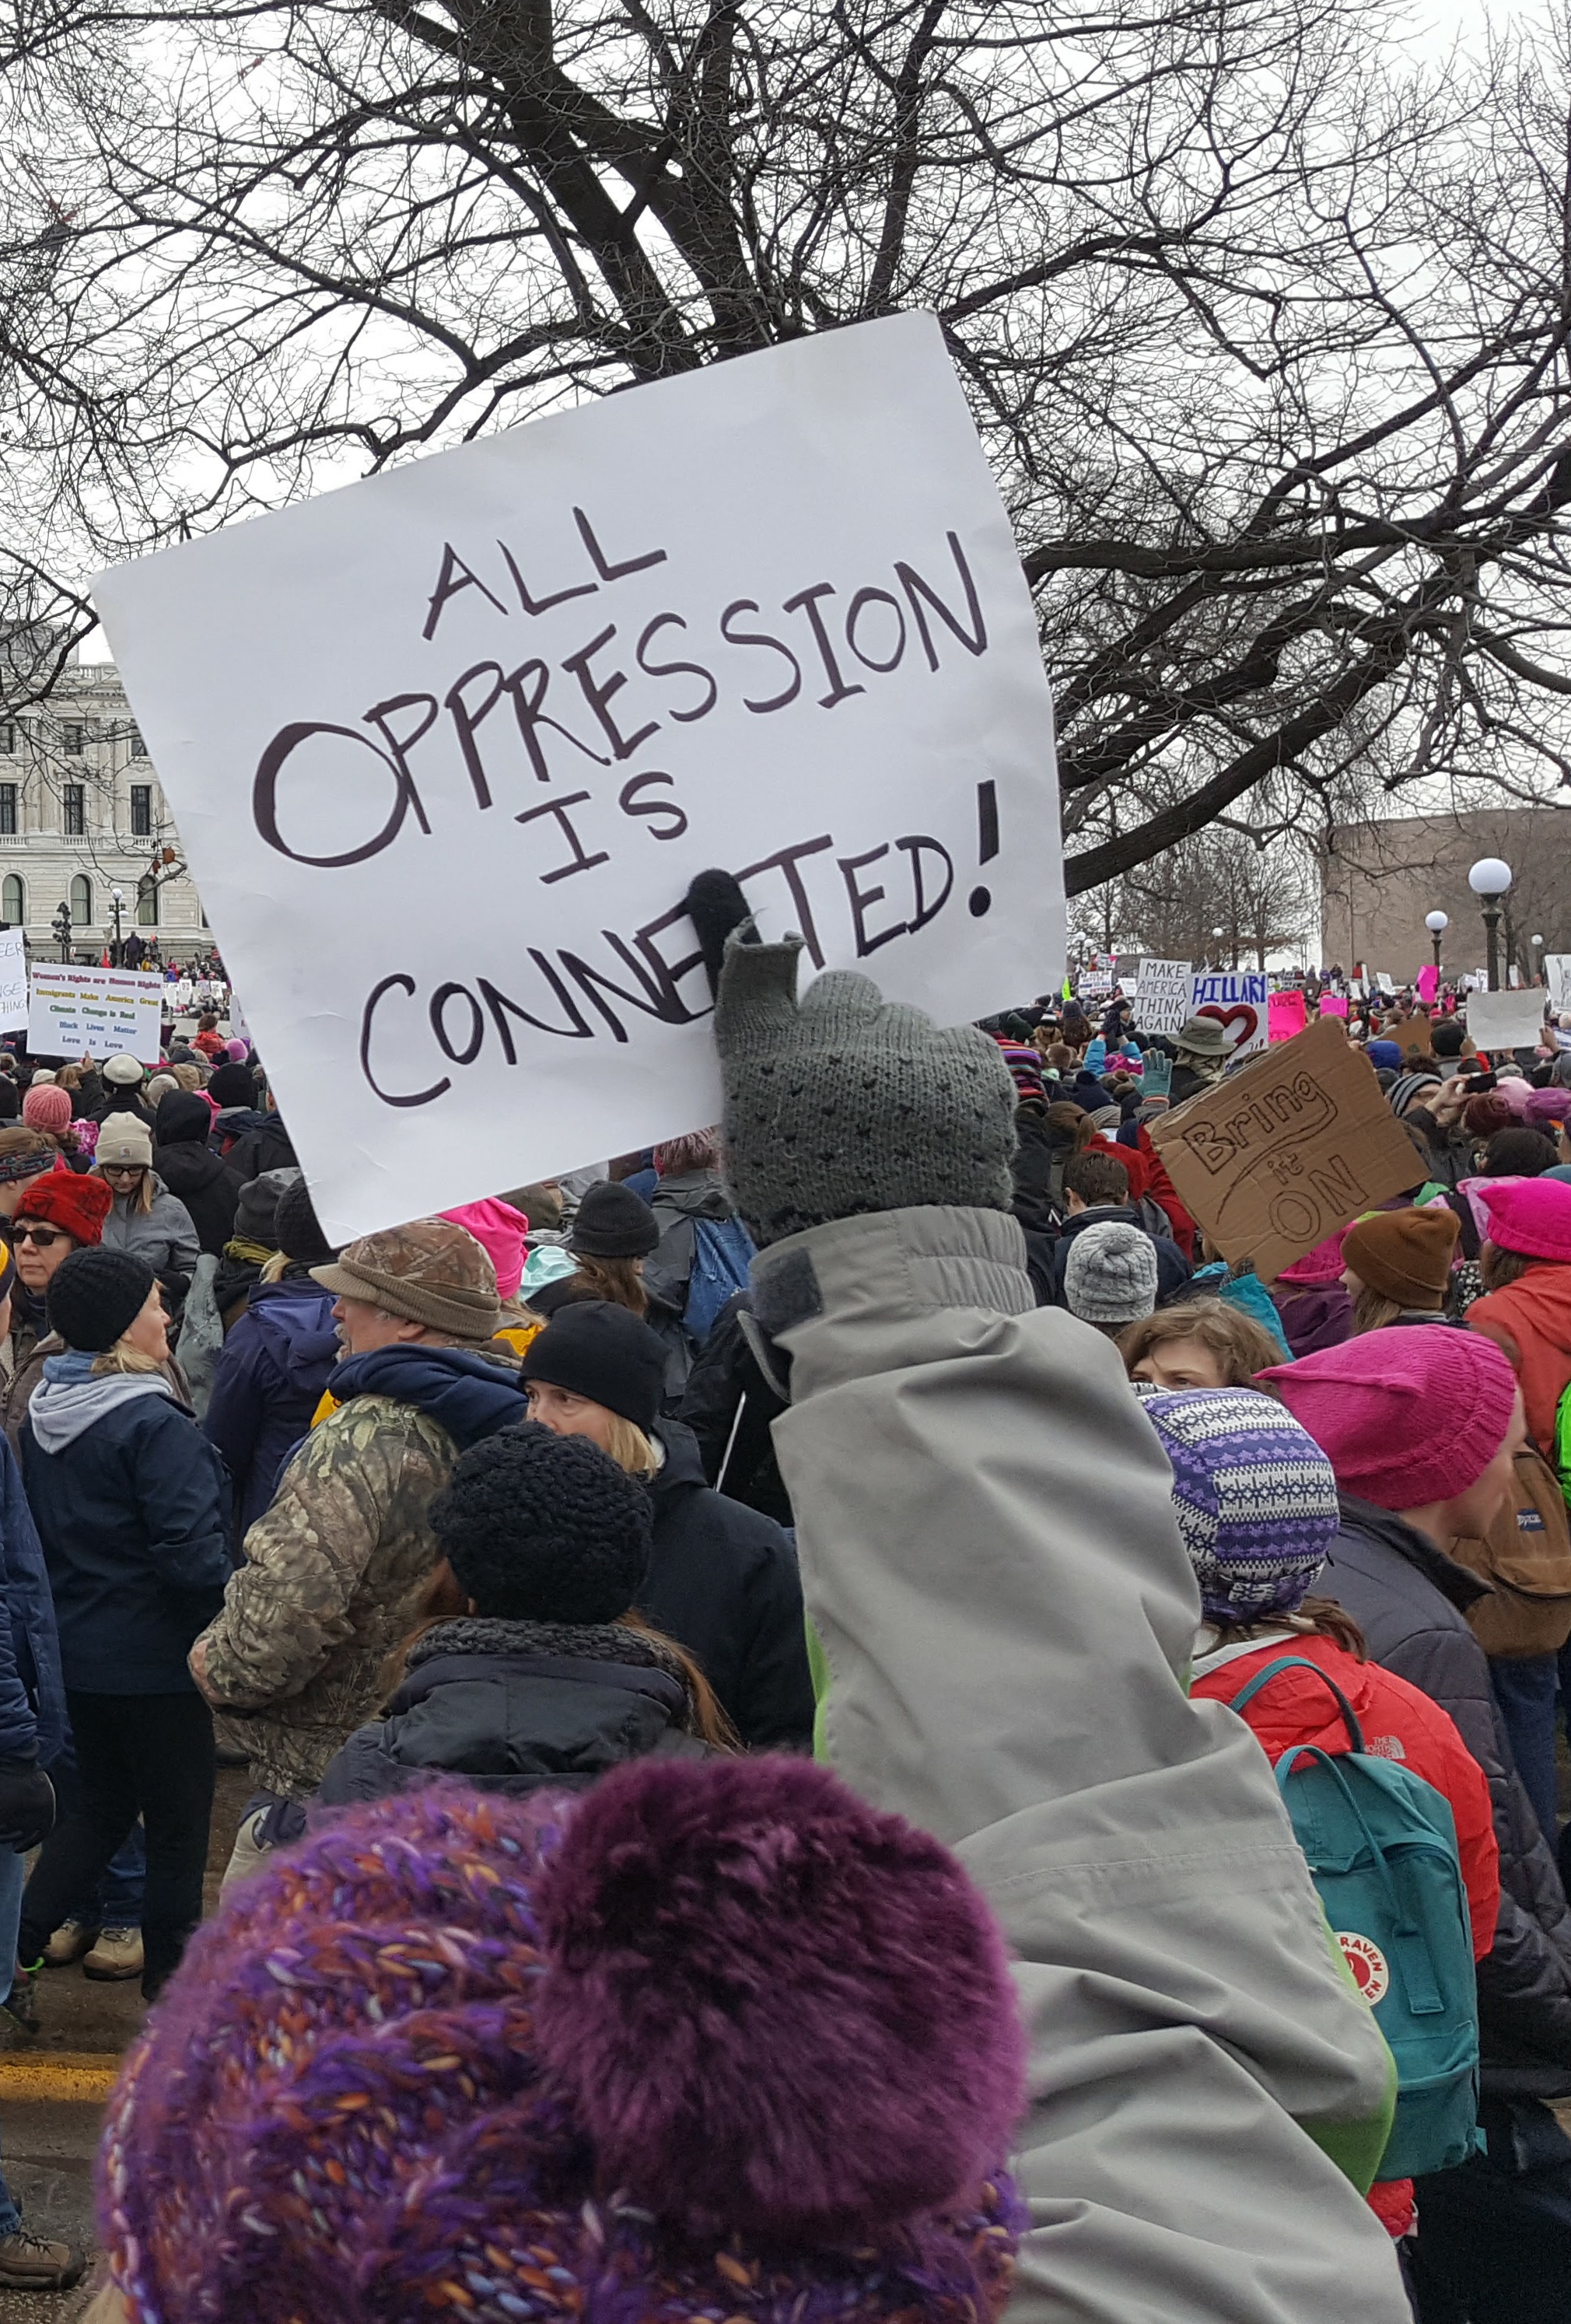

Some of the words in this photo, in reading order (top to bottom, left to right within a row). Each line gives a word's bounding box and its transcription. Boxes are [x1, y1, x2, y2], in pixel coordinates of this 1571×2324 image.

[422, 506, 668, 641] ALL
[252, 530, 989, 868] OPPRESSION
[514, 771, 688, 885] IS
[359, 779, 1001, 1108] CONNETED!
[32, 971, 66, 982] Women's
[68, 975, 91, 983] Rights
[109, 977, 135, 986] Human
[137, 980, 161, 989] Rights
[1145, 962, 1188, 979] MAKE
[36, 988, 76, 998] Immigrants
[79, 992, 99, 1001] Make
[105, 994, 135, 1005] America
[139, 997, 159, 1006] Great
[1136, 979, 1187, 999] AMERICA
[1191, 974, 1266, 1006] HILLARY
[50, 1004, 76, 1013] Climate
[82, 1006, 107, 1017] Change
[120, 1010, 135, 1020] Real
[1136, 996, 1185, 1015] THINK
[59, 1020, 79, 1030] Black
[86, 1023, 105, 1031] Lives
[113, 1025, 138, 1034] Matter
[61, 1034, 81, 1045] Love
[104, 1040, 124, 1049] Love
[1181, 1071, 1338, 1207] Bring
[1267, 1151, 1304, 1186] it
[1268, 1154, 1370, 1243] ON
[1372, 1735, 1390, 1744] THE
[1339, 1937, 1383, 1972] RAVEN
